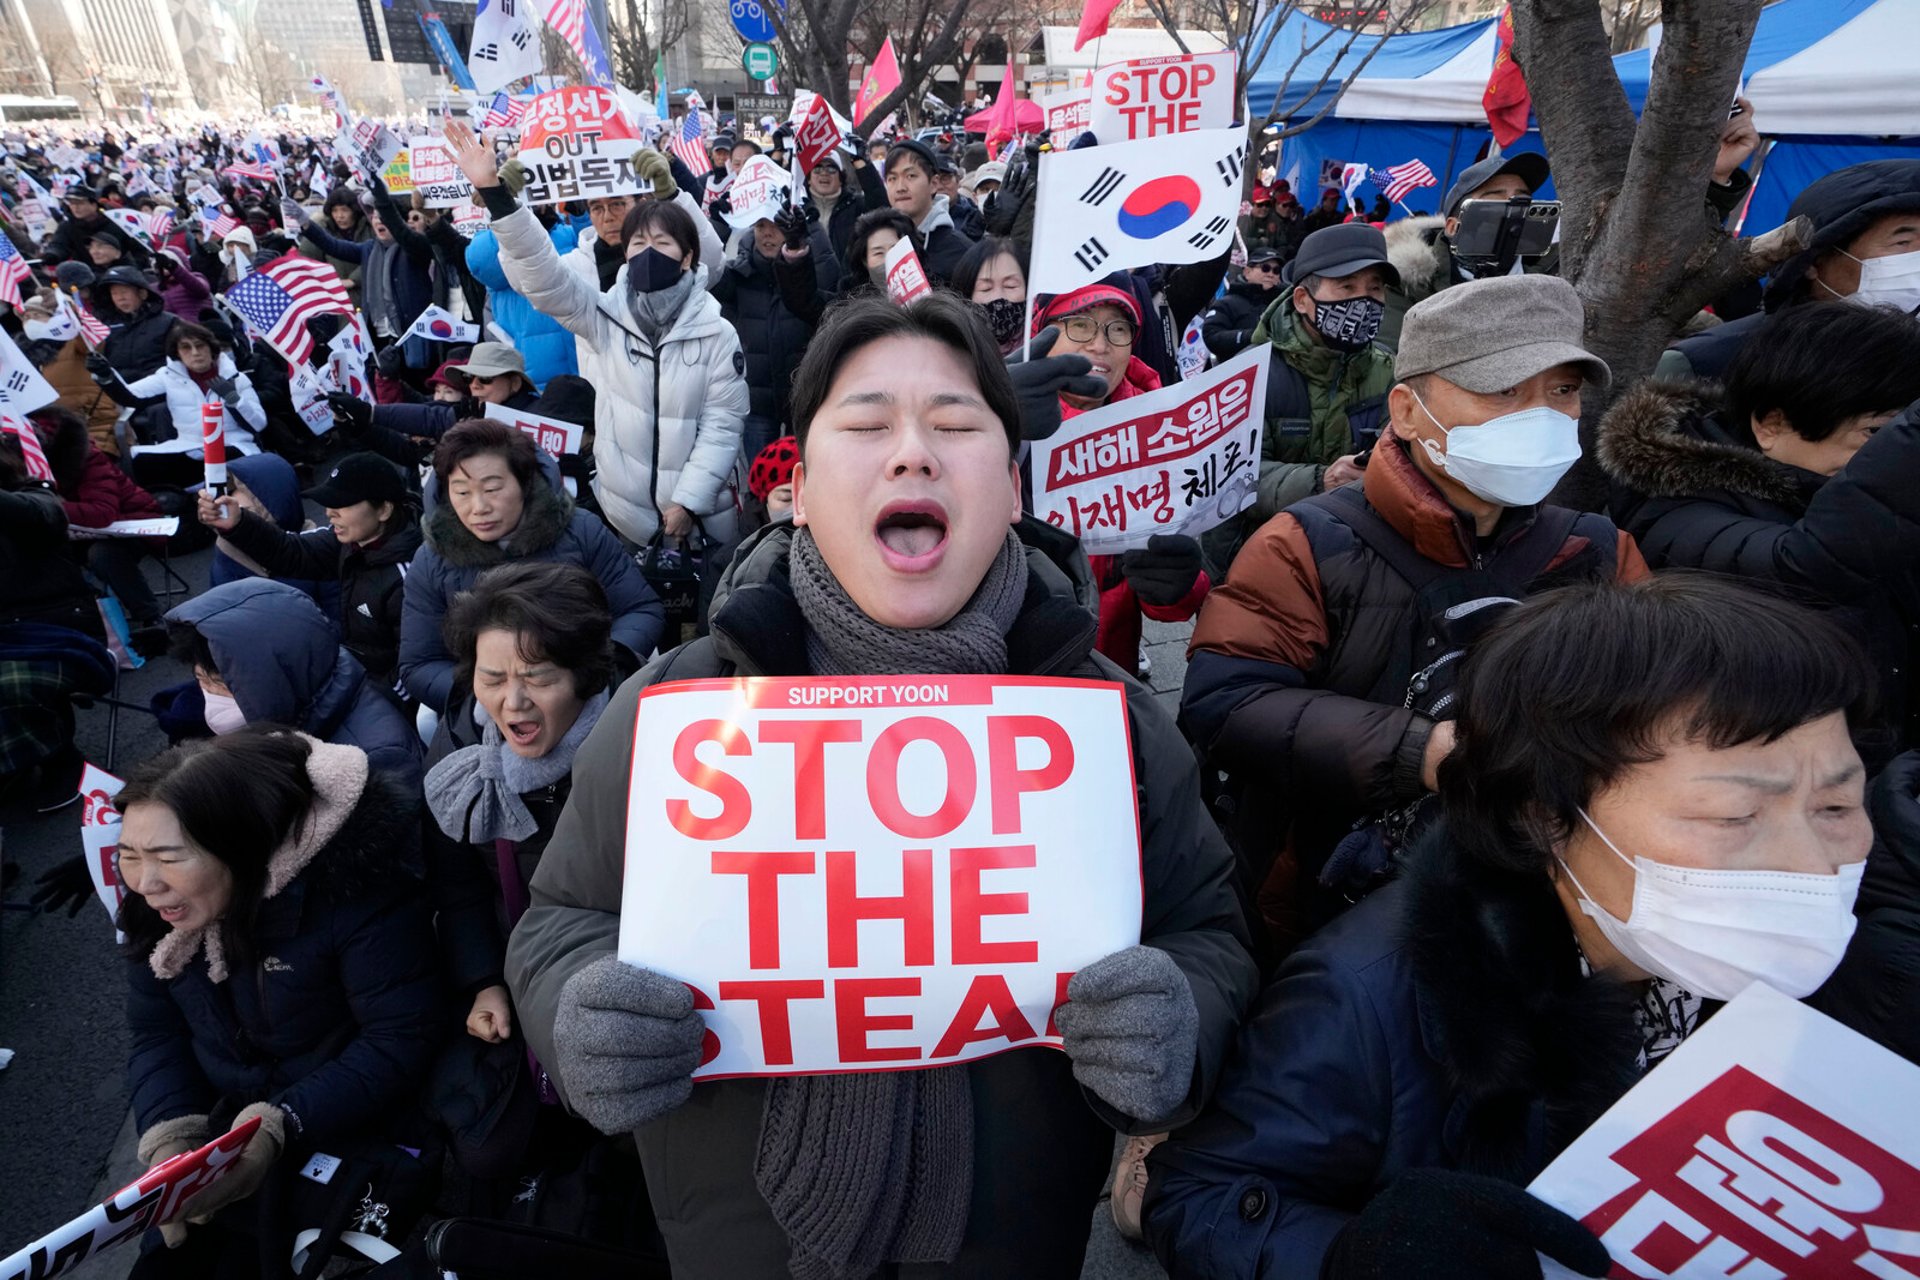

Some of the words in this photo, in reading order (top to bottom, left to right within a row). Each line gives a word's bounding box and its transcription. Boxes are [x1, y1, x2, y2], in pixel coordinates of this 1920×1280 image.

[1105, 64, 1216, 106] STOP
[1119, 101, 1201, 140] THE
[545, 132, 602, 159] OUT
[523, 157, 650, 203] 입법독재
[733, 183, 767, 210] 재명
[1056, 425, 1140, 482] 새해
[1148, 378, 1248, 458] 소원은
[1047, 470, 1174, 537] 이재명
[1181, 429, 1257, 506] 체포!
[788, 687, 887, 705] SUPPORT
[891, 685, 950, 704] YOON
[665, 715, 1075, 841] STOP
[711, 845, 1038, 970] THE
